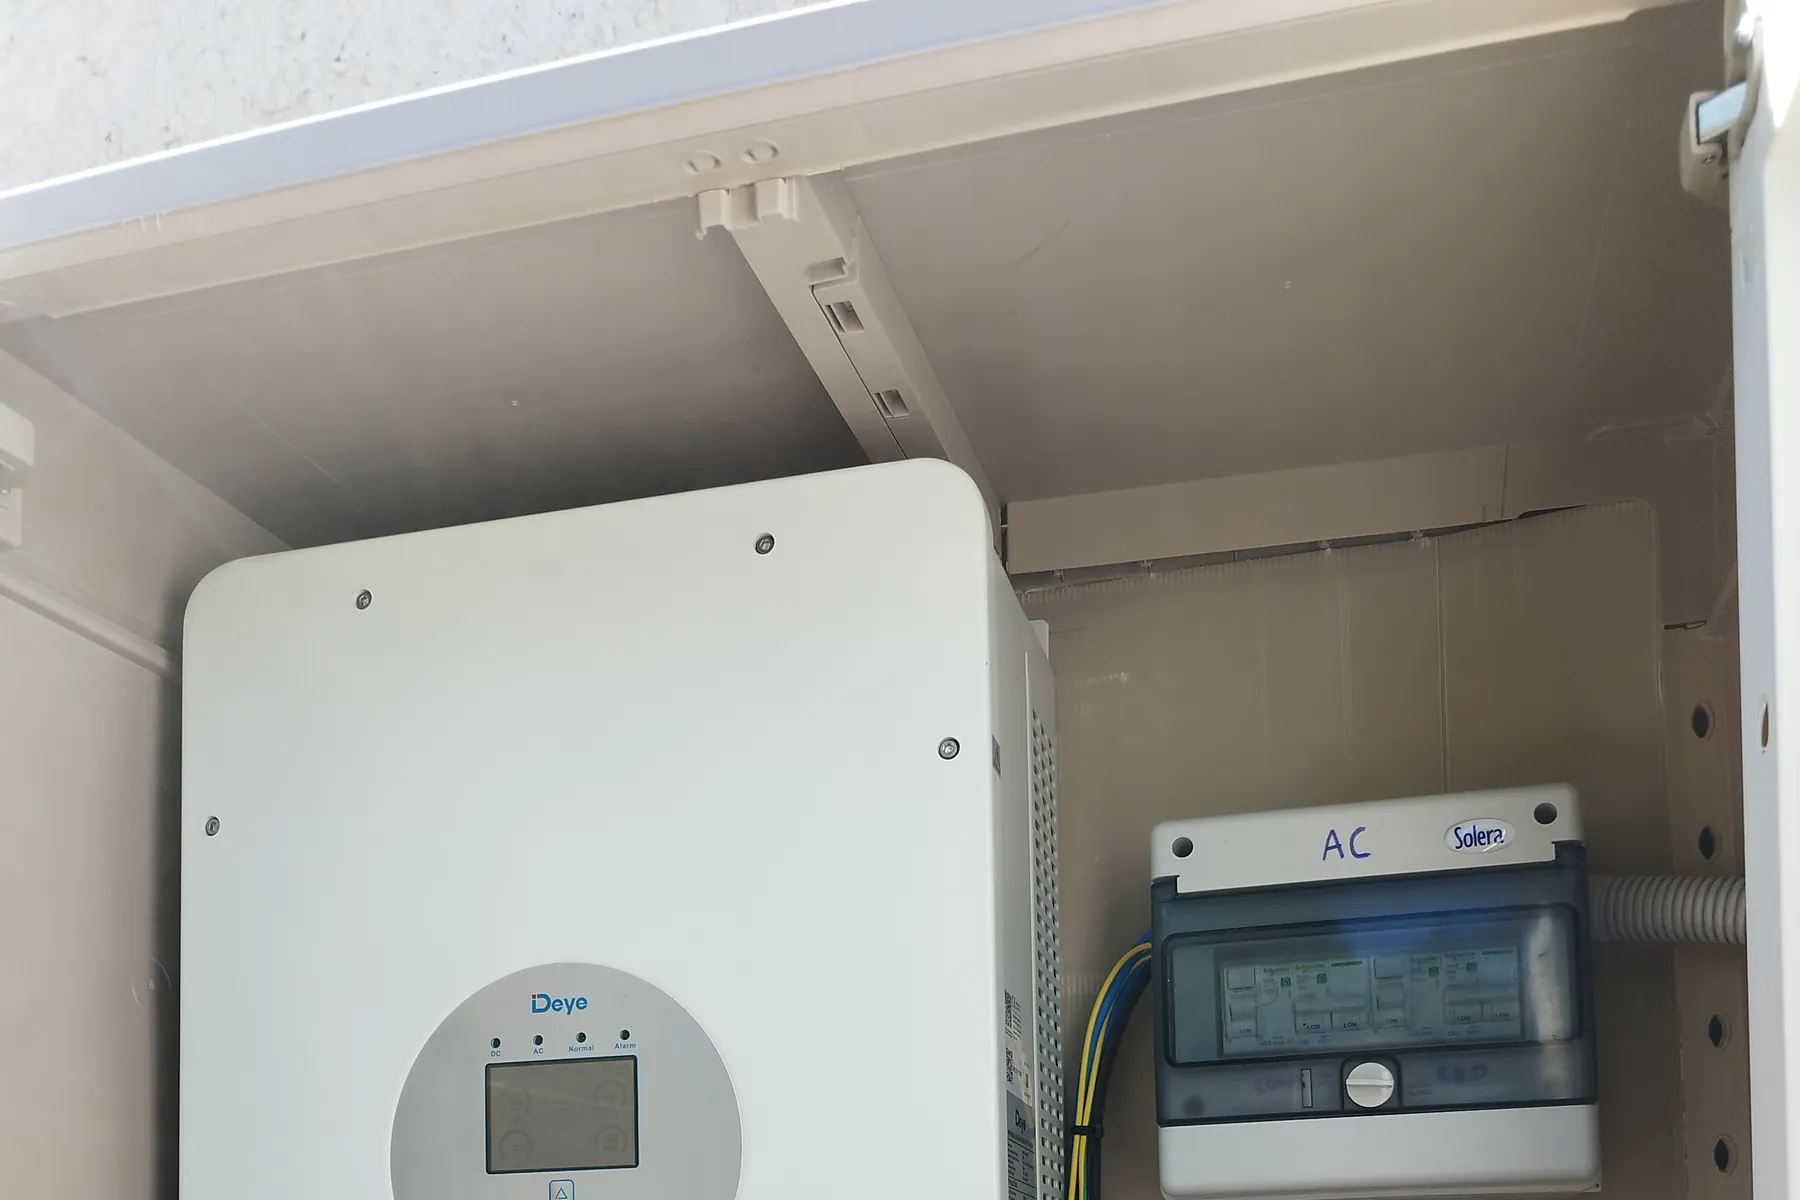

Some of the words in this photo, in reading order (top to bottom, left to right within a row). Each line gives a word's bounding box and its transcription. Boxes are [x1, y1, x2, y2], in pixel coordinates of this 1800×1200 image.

[1322, 826, 1371, 861] AC
[1453, 825, 1505, 850] Solera
[531, 993, 588, 1015] Deye
[533, 1047, 544, 1055] AC
[568, 1044, 595, 1053] Normal
